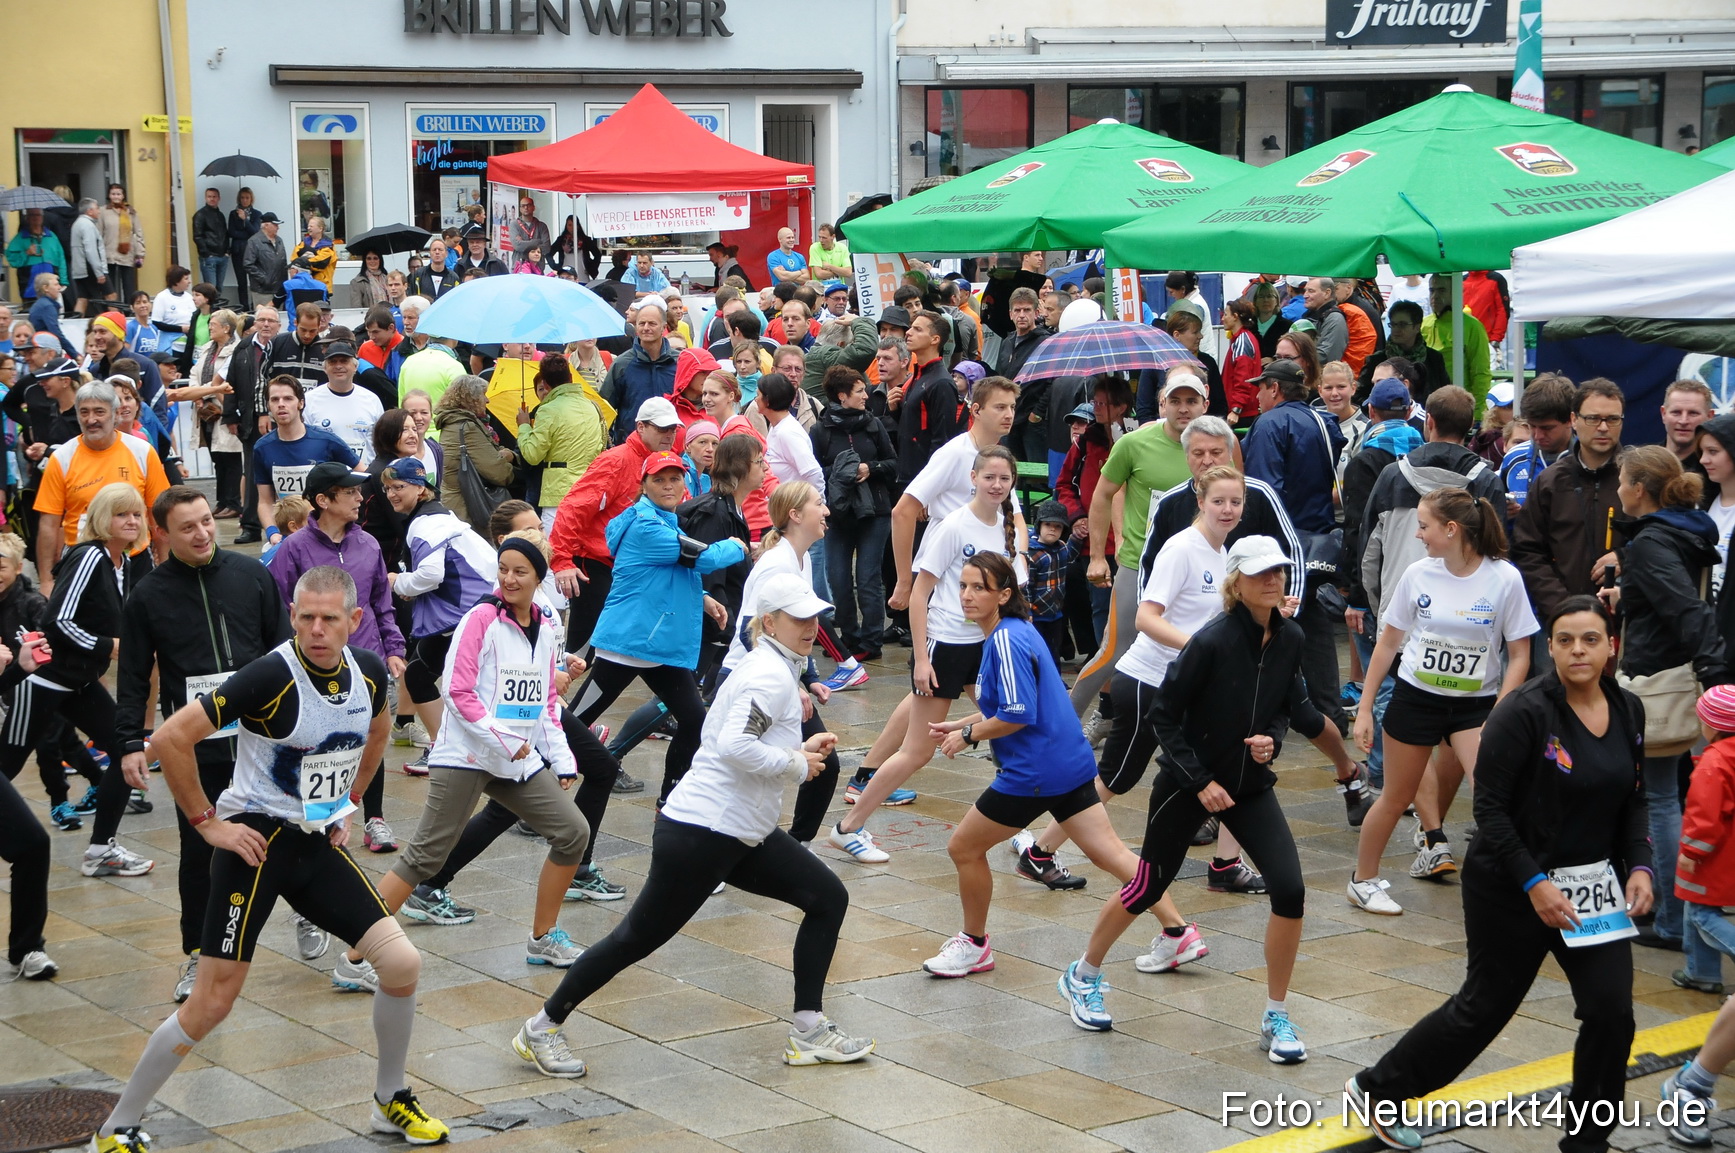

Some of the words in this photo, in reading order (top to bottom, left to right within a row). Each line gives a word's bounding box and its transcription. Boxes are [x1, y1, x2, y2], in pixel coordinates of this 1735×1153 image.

[404, 0, 571, 35] BRILLEN
[580, 0, 734, 37] WEBER
[424, 116, 482, 132] BRILLEN
[486, 116, 540, 132] WEBER
[138, 148, 158, 162] 24
[417, 137, 455, 171] light
[438, 161, 451, 169] die
[1137, 187, 1211, 197] Neuma
[1503, 181, 1646, 200] Neumarkter
[1241, 193, 1333, 207] Neumarkter
[1491, 192, 1672, 217] Lammsbrä
[592, 211, 630, 224] WERDE
[633, 206, 716, 221] LEBENSRETTER!
[1198, 206, 1324, 224] Lammsbräu
[604, 224, 626, 232] LASS
[629, 222, 652, 230] DICH
[656, 219, 709, 228] TYPISIEREN.
[857, 266, 876, 317] klebl.de
[277, 477, 306, 492] 221
[1305, 560, 1337, 573] adidas
[1421, 637, 1442, 647] PARTL
[1445, 643, 1477, 652] Neumarkt
[1423, 647, 1481, 676] 5037
[500, 668, 521, 677] PARTL
[1436, 677, 1458, 688] Lena
[504, 679, 542, 702] 3029
[519, 708, 531, 718] Eva
[303, 761, 328, 770] PARTL
[1550, 875, 1579, 884] PARTL
[1580, 920, 1611, 935] Angela
